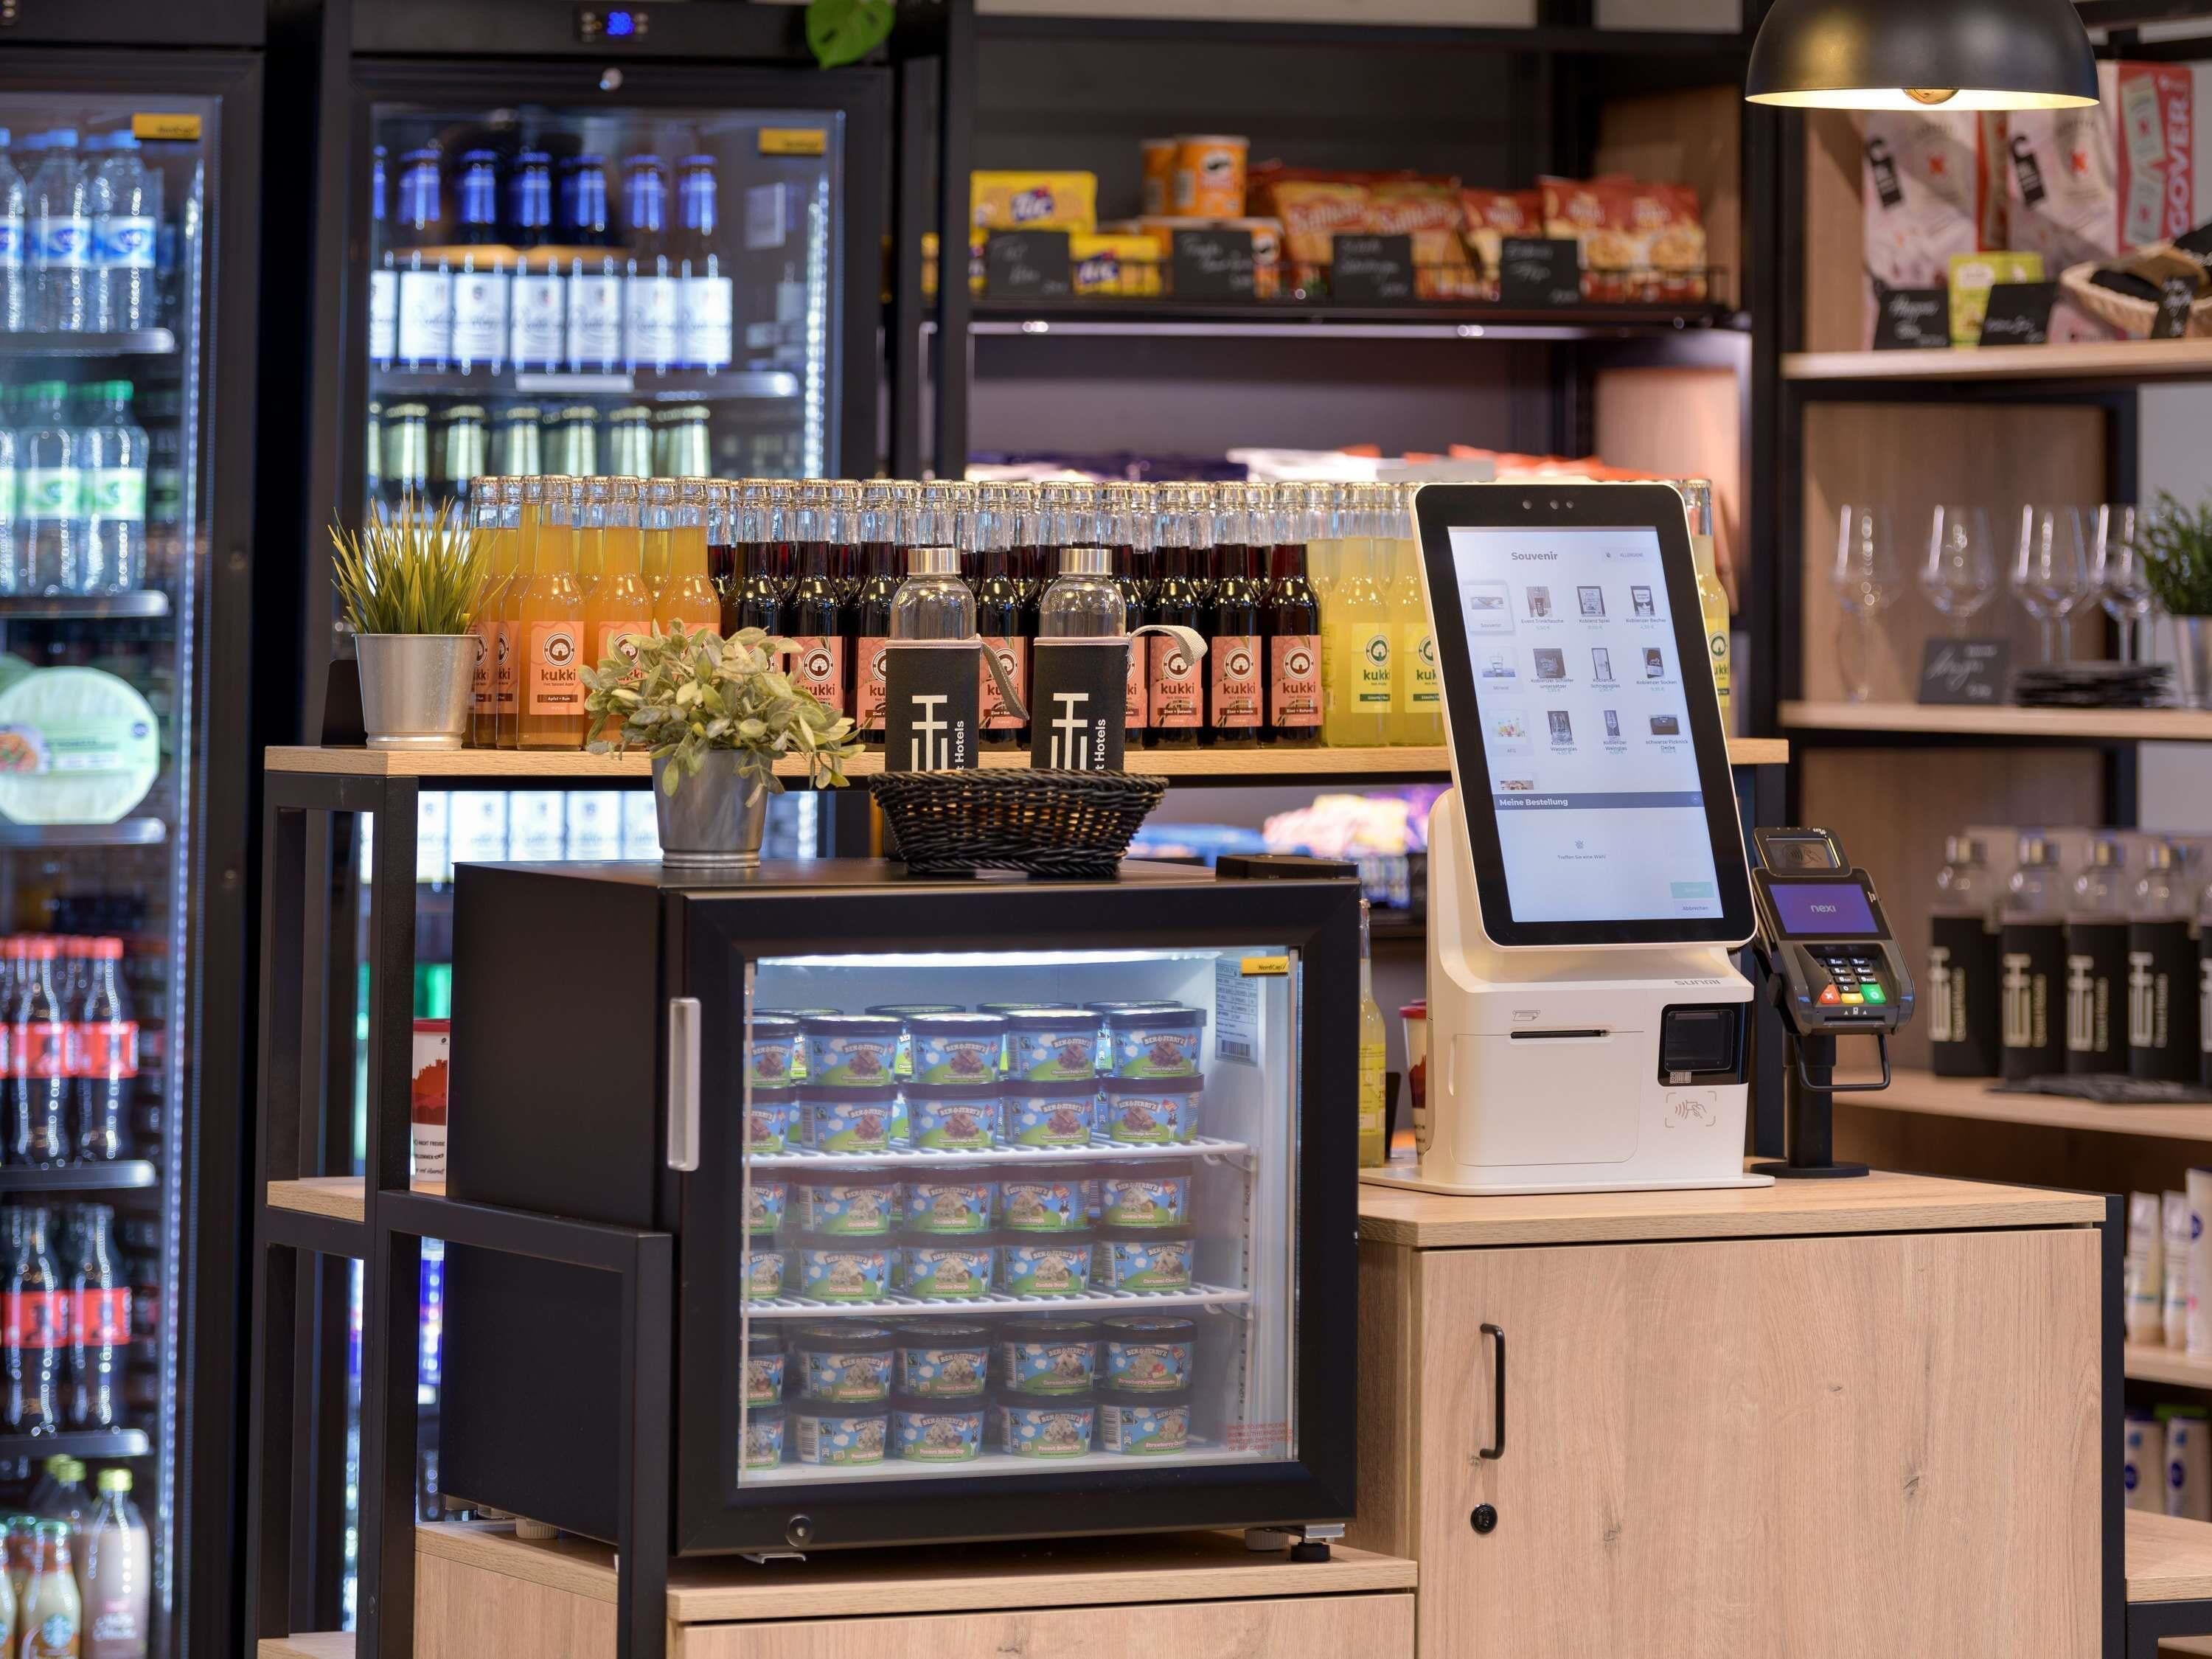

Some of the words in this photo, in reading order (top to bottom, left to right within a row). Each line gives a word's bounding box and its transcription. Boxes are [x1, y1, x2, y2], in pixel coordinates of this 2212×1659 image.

[1511, 551, 1558, 560] Souvenir
[498, 669, 510, 681] kki
[541, 669, 576, 681] kukki
[1416, 669, 1437, 681] kuk
[987, 684, 1019, 696] kui
[1161, 683, 1195, 695] kukki
[1223, 683, 1256, 695] kukki
[1283, 682, 1315, 694] kukki
[955, 720, 964, 762] Hotels
[1094, 719, 1106, 762] Hotels
[1526, 798, 1568, 807] Bestellung
[1810, 905, 1837, 914] nexi
